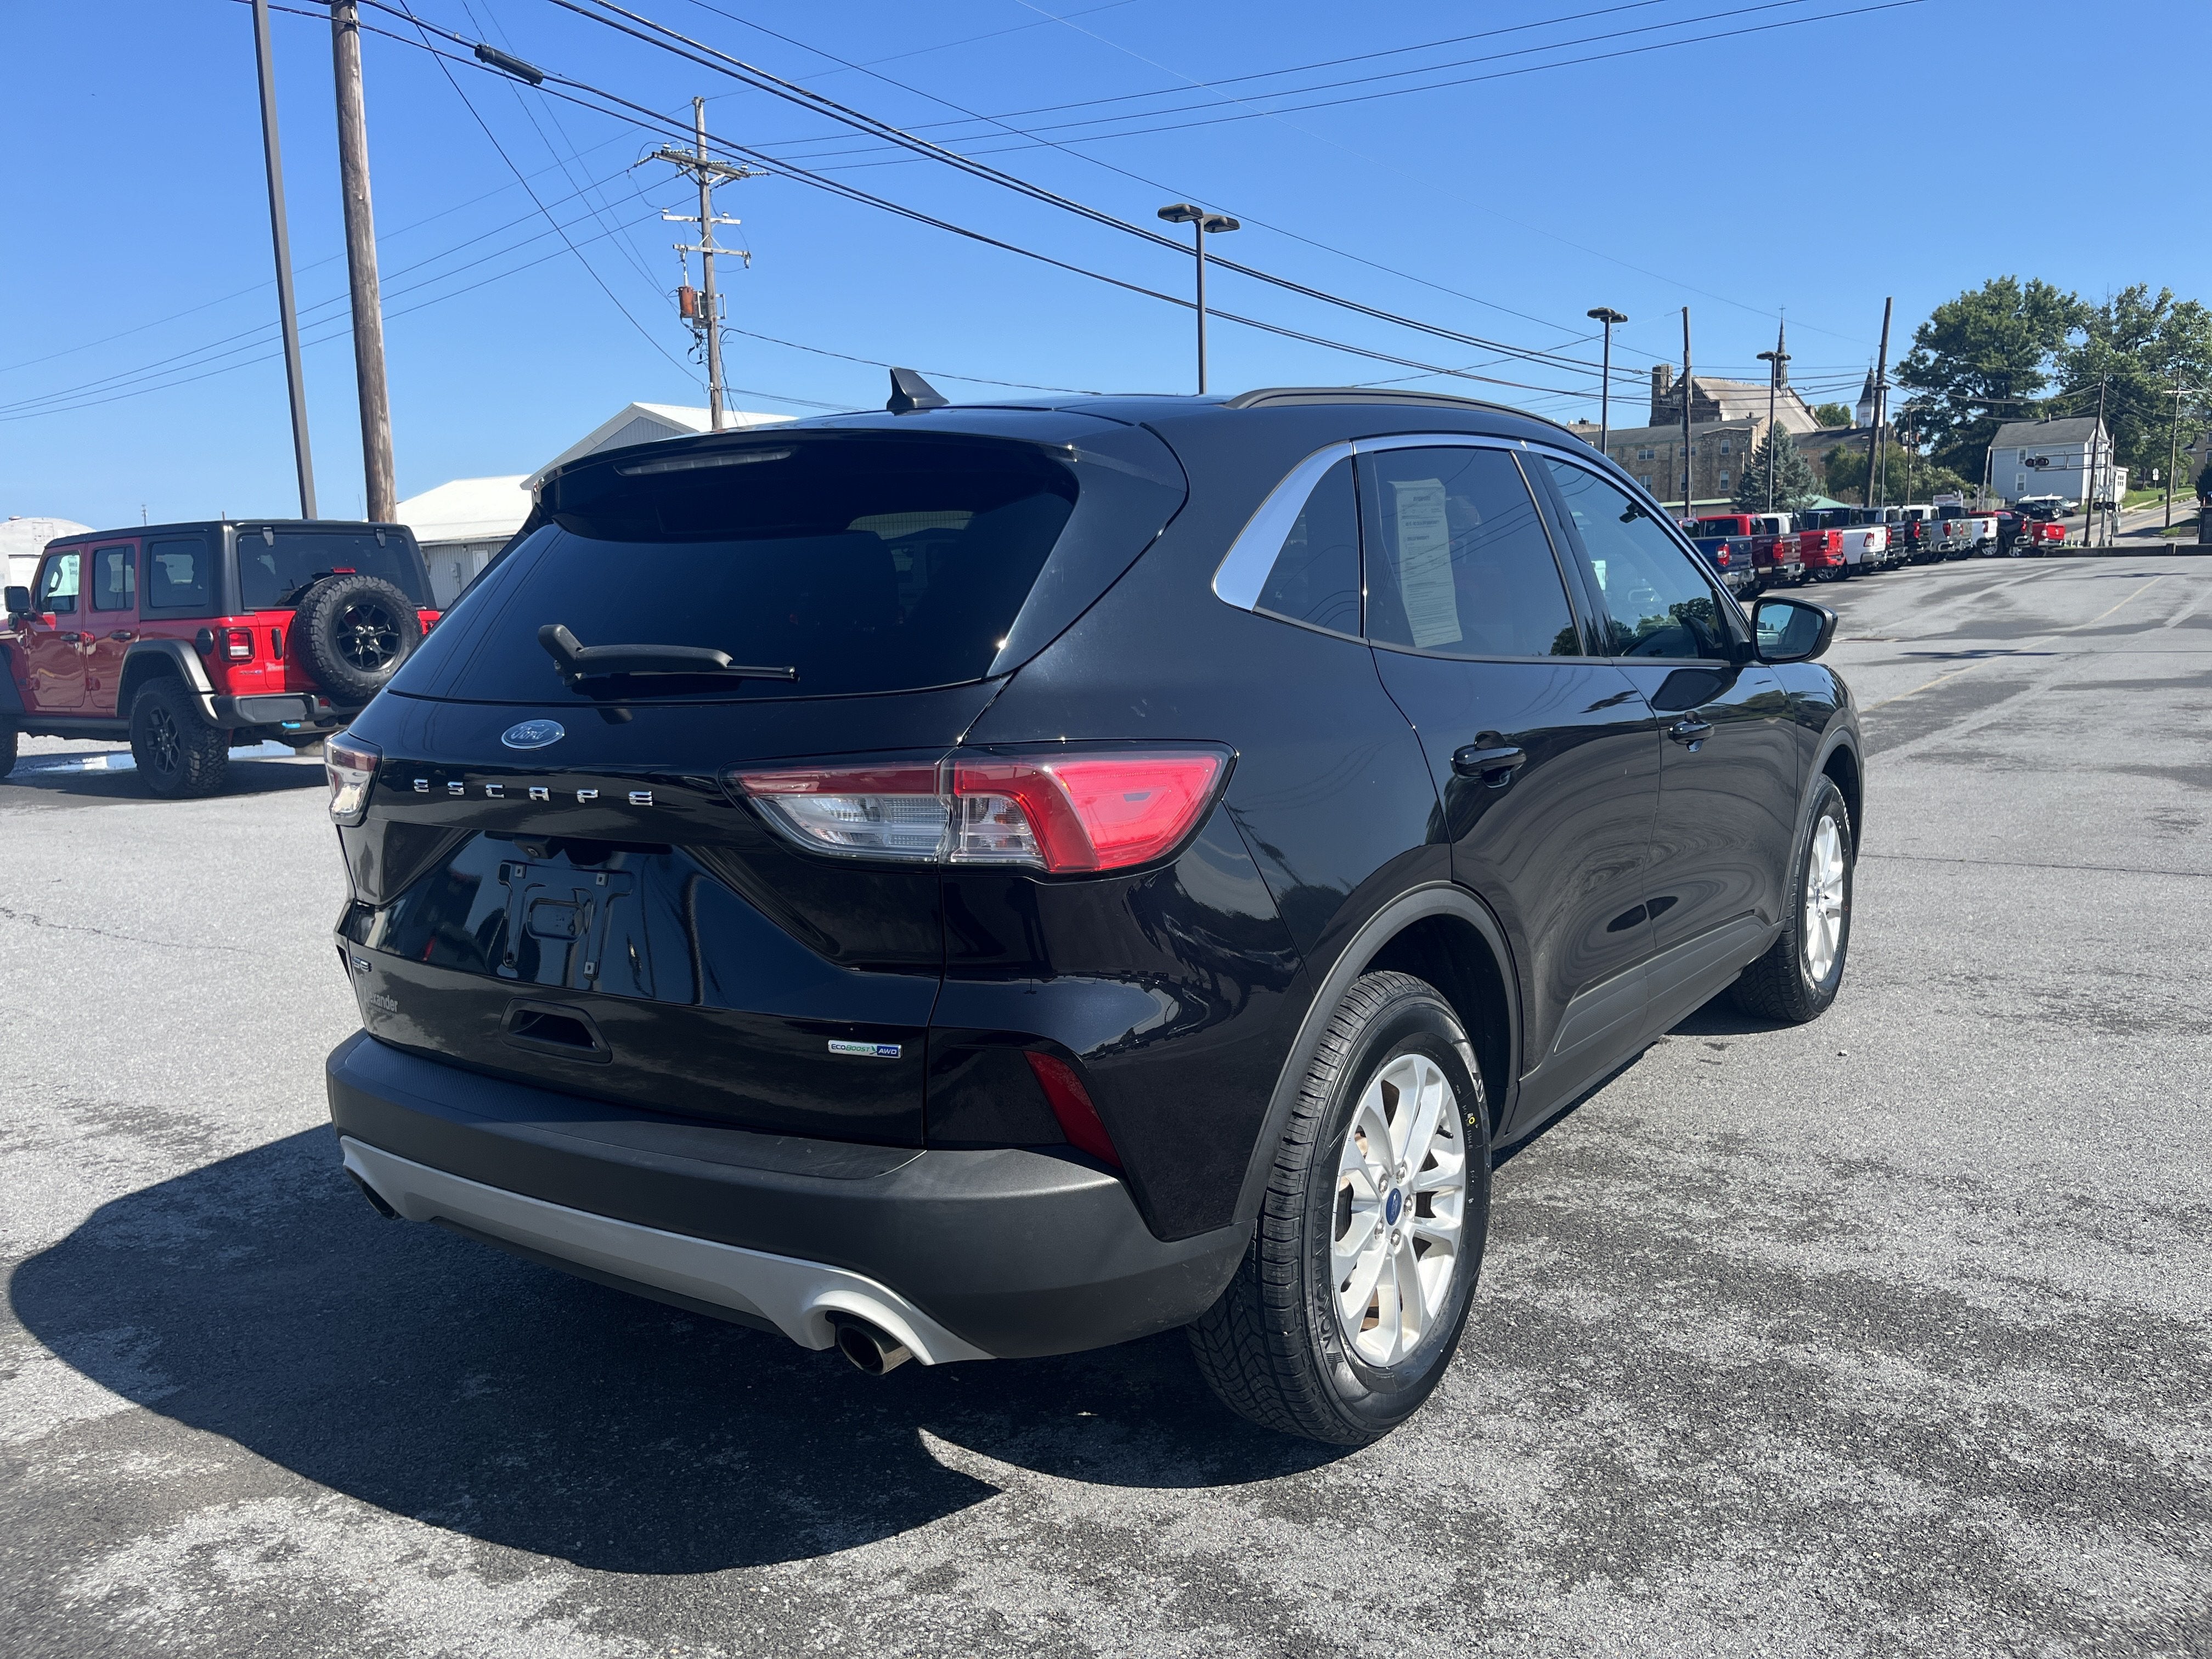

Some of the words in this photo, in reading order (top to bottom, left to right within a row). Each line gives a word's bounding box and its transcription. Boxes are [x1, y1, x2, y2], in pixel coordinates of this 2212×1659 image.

[413, 778, 653, 806] ESCAPE
[831, 1043, 871, 1052] ECOBOOST
[1315, 1200, 1335, 1350] YOKOHAMA
